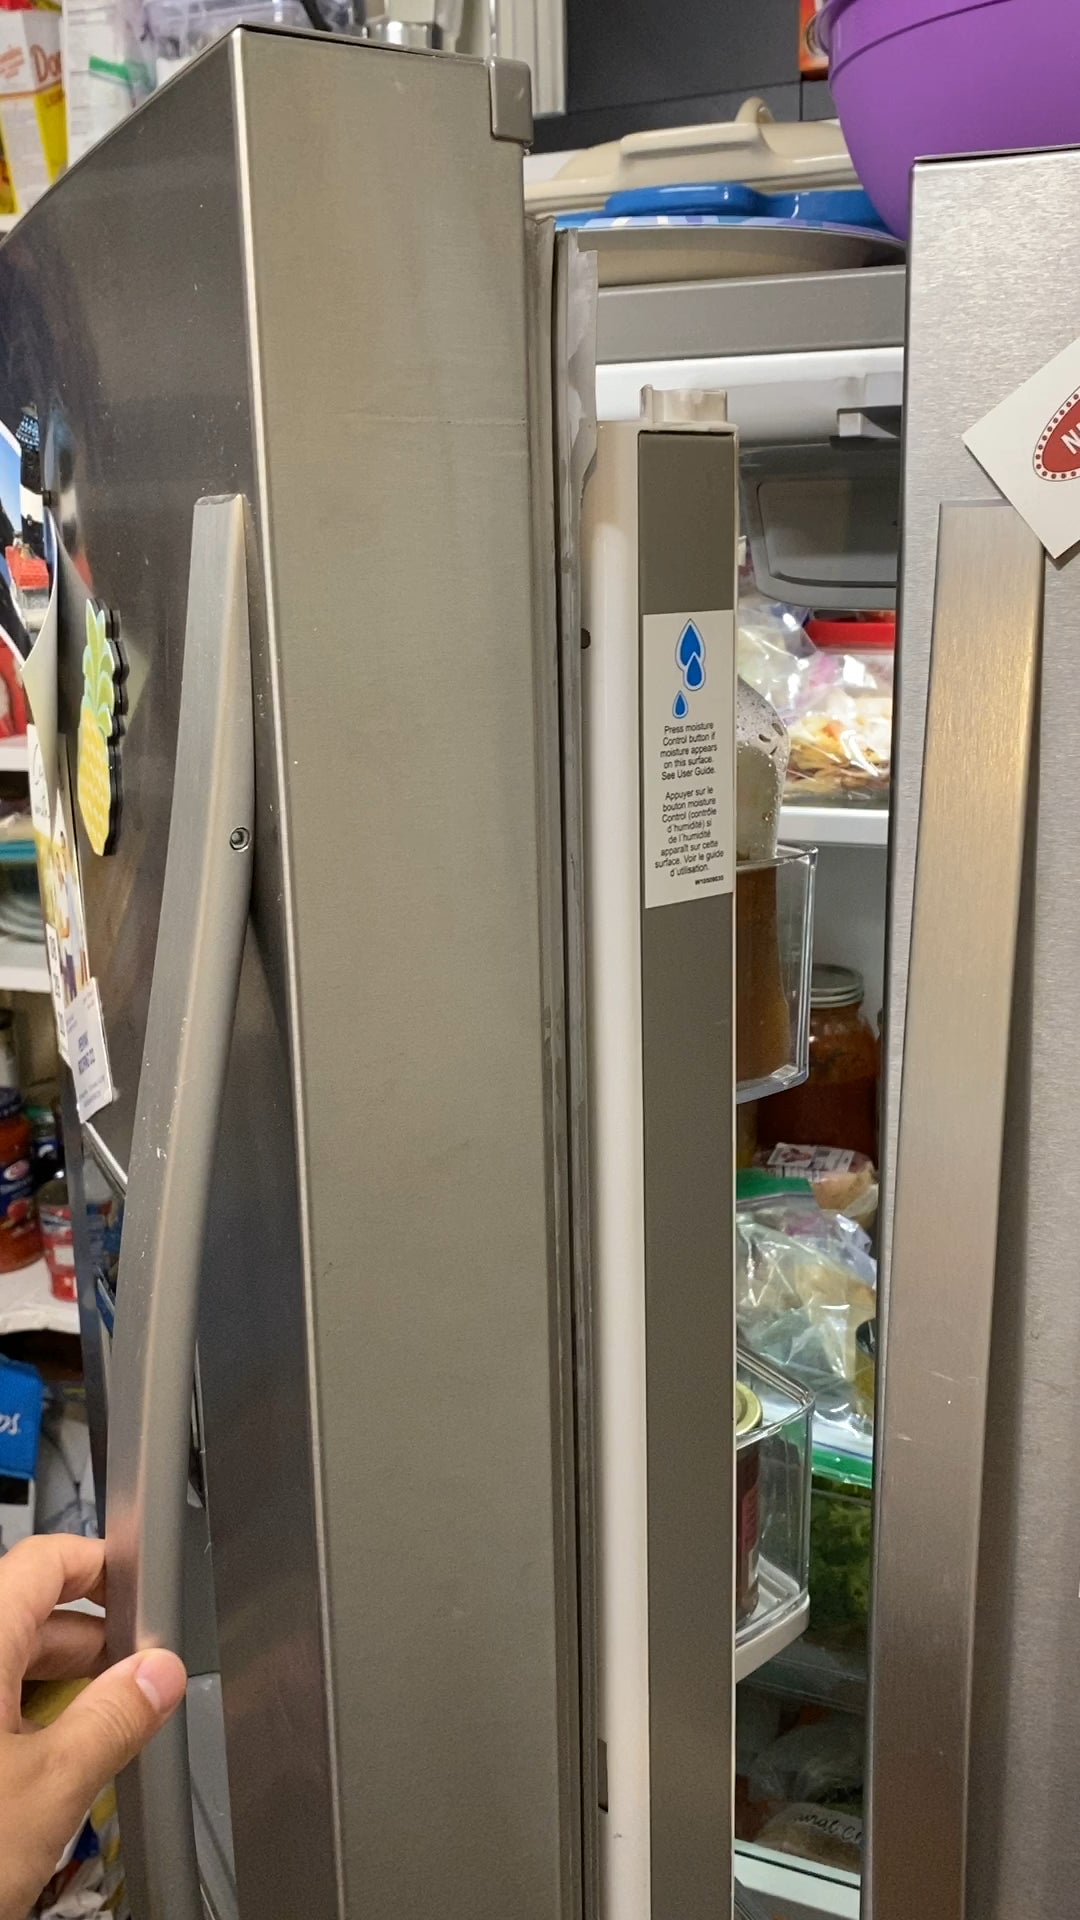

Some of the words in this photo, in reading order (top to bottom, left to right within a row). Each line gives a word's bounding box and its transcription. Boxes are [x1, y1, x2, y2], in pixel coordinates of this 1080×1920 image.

[664, 725, 684, 735] Press
[685, 722, 714, 732] moisture
[663, 735, 687, 746] Control
[689, 733, 709, 743] button
[711, 731, 716, 740] if
[660, 748, 689, 758] moisture
[691, 744, 717, 755] appears
[664, 761, 673, 769] on
[674, 759, 686, 767] this
[661, 771, 675, 781] See
[677, 770, 693, 778] User
[665, 790, 693, 802] Appuyer
[695, 788, 706, 796] sur
[707, 785, 713, 794] le
[662, 802, 687, 812] bouton
[688, 798, 716, 808] moisture
[662, 811, 686, 823] Control
[688, 807, 717, 820] (contrôle
[706, 818, 712, 827] si
[668, 836, 677, 844] de
[690, 843, 701, 851] sur
[702, 840, 718, 849] cette
[683, 854, 697, 863] Voir
[706, 850, 724, 862] guide
